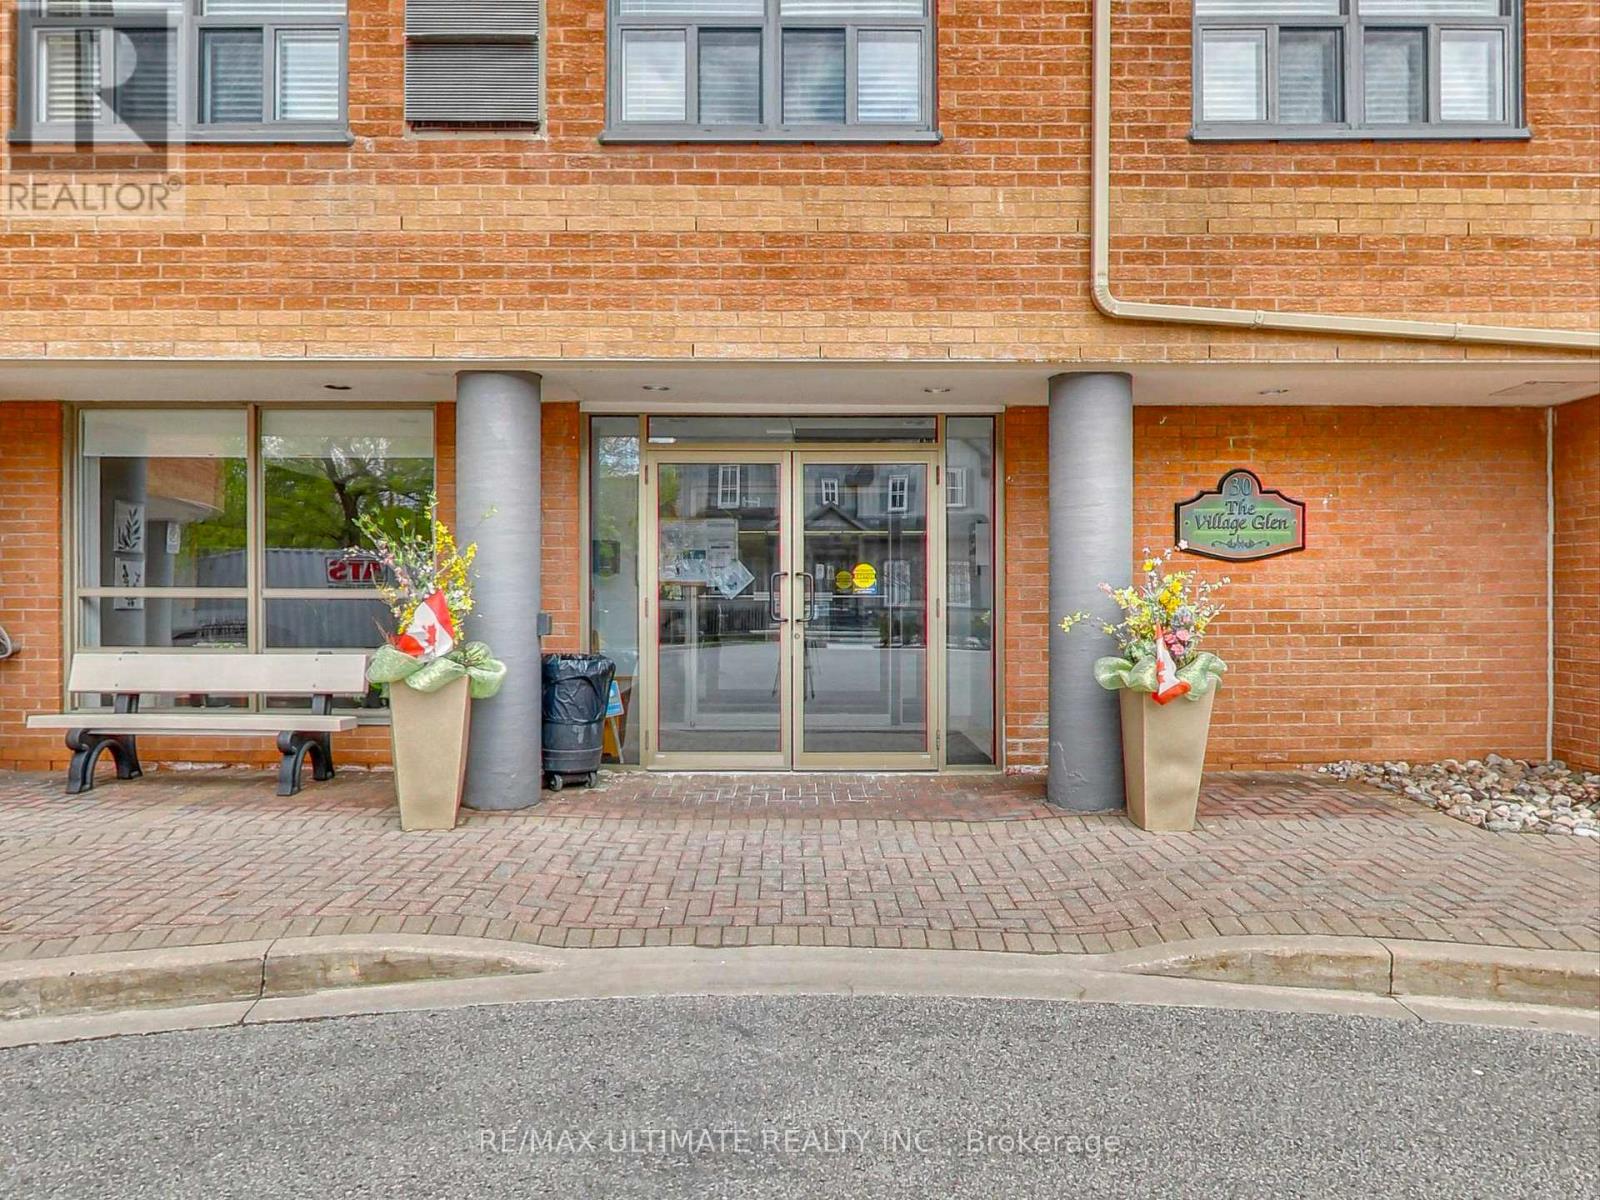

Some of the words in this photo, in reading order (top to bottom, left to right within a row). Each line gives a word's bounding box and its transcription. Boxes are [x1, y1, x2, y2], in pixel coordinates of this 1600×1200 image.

[1229, 477, 1252, 496] 30
[1225, 499, 1256, 516] The
[1195, 512, 1248, 536] Village
[1252, 513, 1289, 530] Glen
